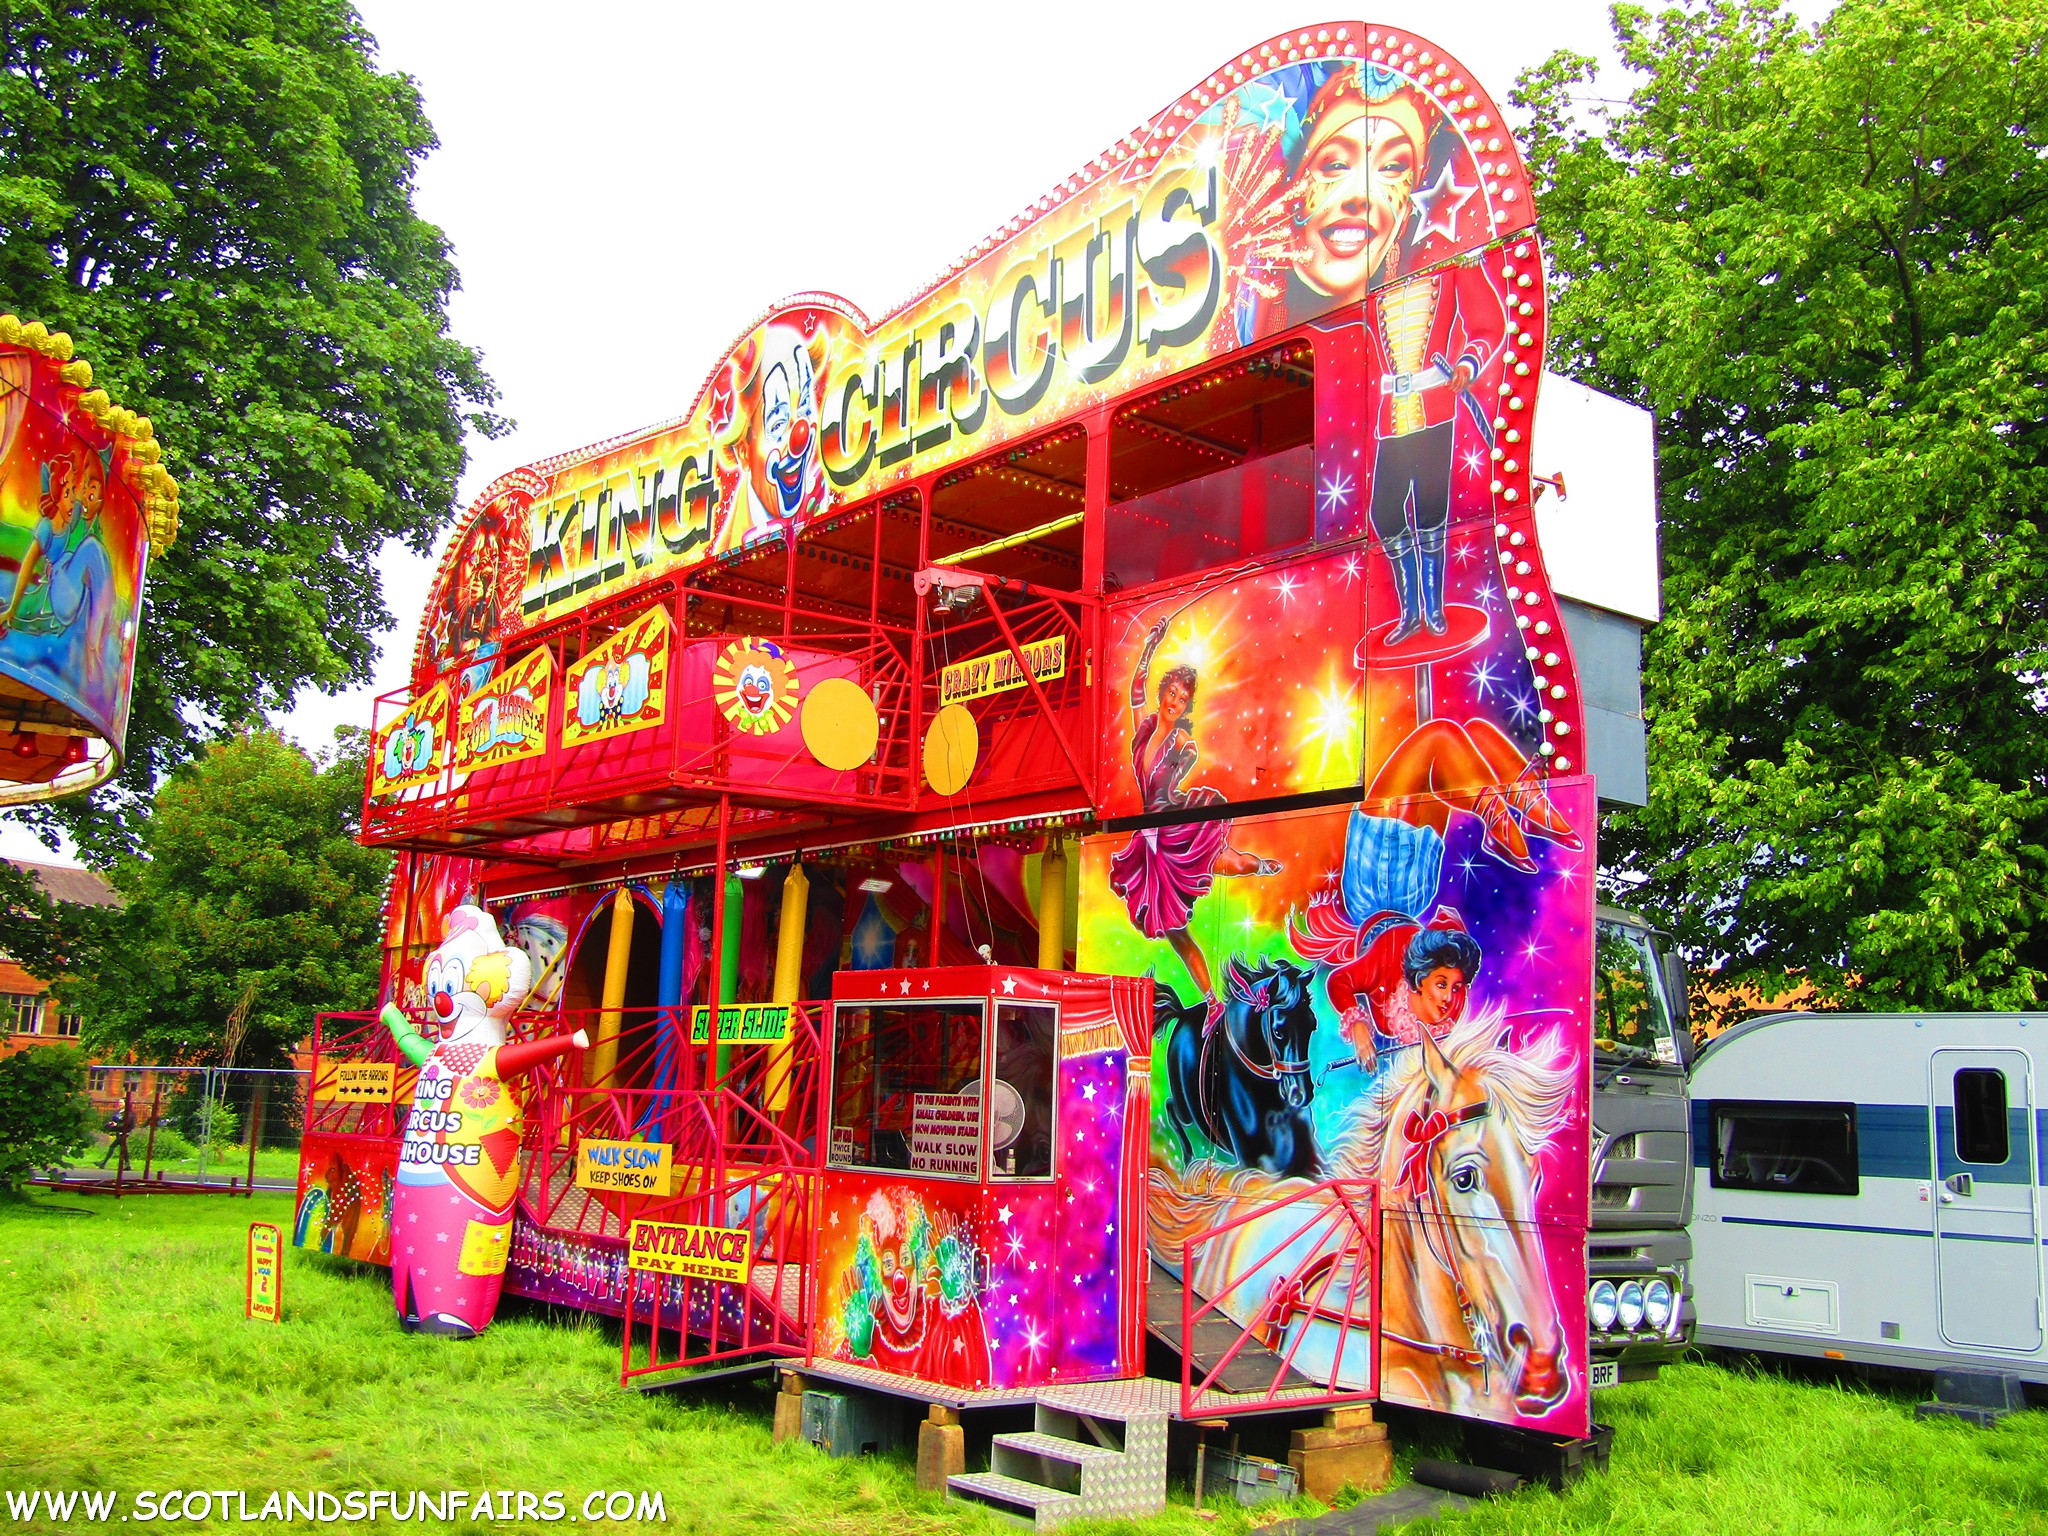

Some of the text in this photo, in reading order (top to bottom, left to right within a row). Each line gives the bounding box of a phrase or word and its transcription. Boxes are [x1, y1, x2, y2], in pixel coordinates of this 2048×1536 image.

[522, 164, 1221, 615] KING CIRCUS
[944, 661, 990, 700] CRAZY
[463, 694, 545, 761] FUN HOUSE
[741, 1007, 789, 1039] SLIDE
[340, 1069, 389, 1081] FOLLOW THE ARROWS
[915, 1095, 980, 1107] TO THE PARENTS WITH
[407, 1110, 463, 1134] IRCUS
[930, 1124, 956, 1136] MOVING
[957, 1125, 979, 1137] STAIRS
[400, 1141, 482, 1165] NHOUSE
[588, 1145, 662, 1169] WALK SLOW
[831, 1153, 852, 1163] ROUND
[834, 1144, 850, 1152] TWICE
[914, 1141, 978, 1156] WALK SLOW
[911, 1157, 978, 1173] NO RUNNING
[590, 1171, 657, 1188] KEEP SHOES ON
[633, 1224, 748, 1263] ENTRANCE
[637, 1256, 738, 1279] PAY HERE
[253, 1303, 274, 1314] AROUND
[1592, 1364, 1613, 1385] BRF
